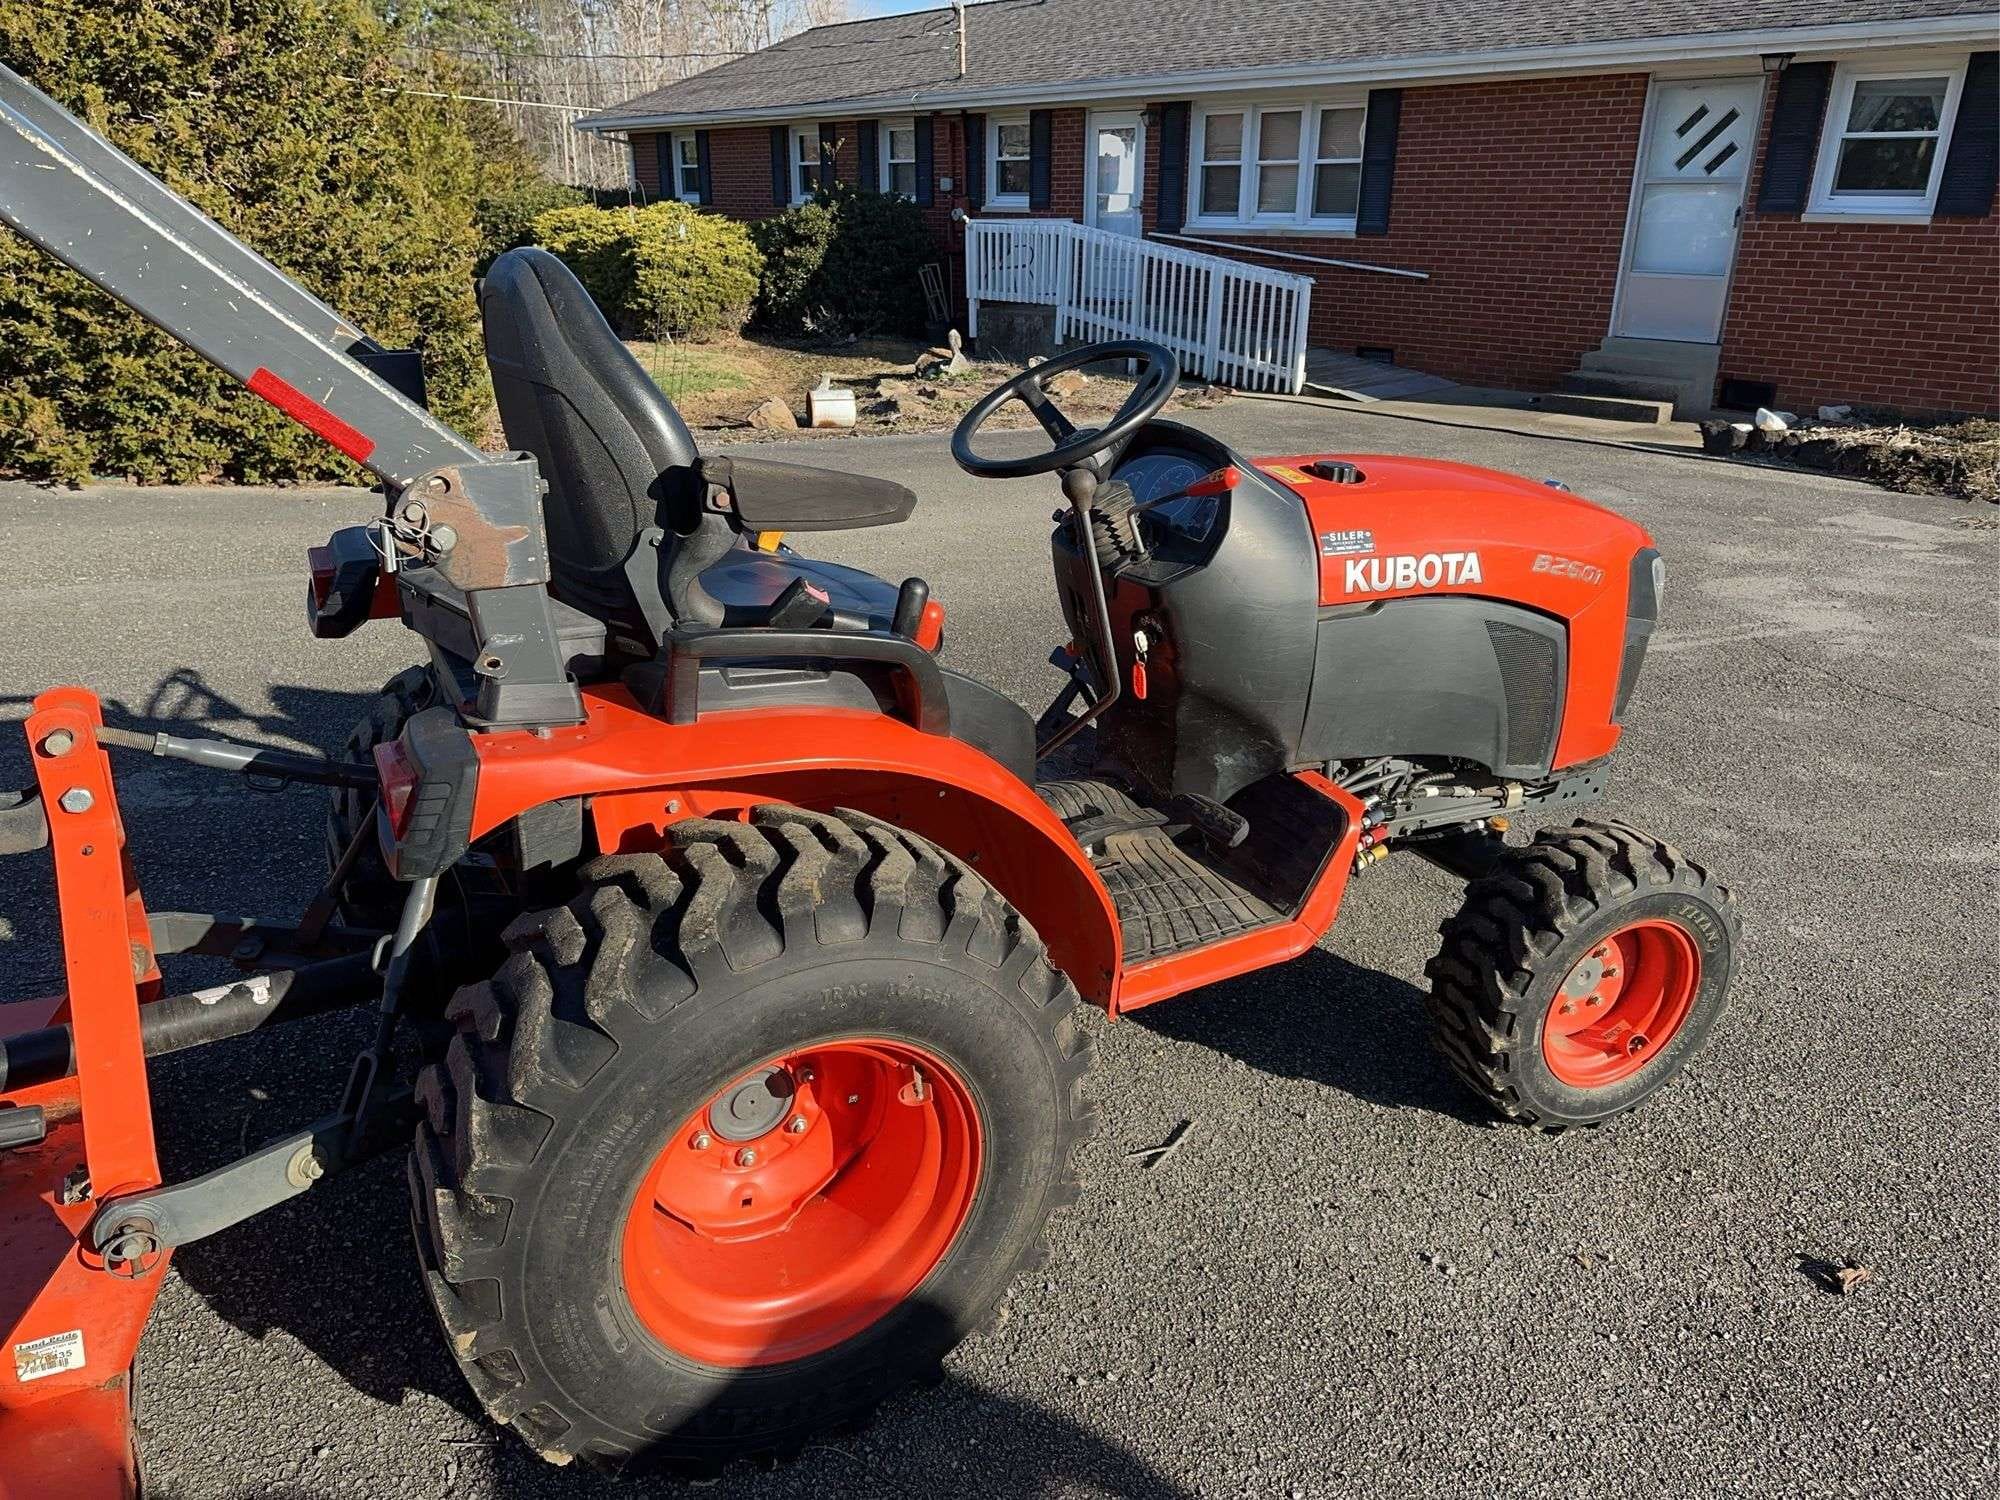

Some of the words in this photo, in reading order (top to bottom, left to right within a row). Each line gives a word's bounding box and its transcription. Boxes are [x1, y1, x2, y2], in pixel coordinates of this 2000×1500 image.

[1329, 531, 1364, 541] SILER
[1344, 552, 1483, 594] KUBOTA
[1532, 554, 1605, 585] B2601
